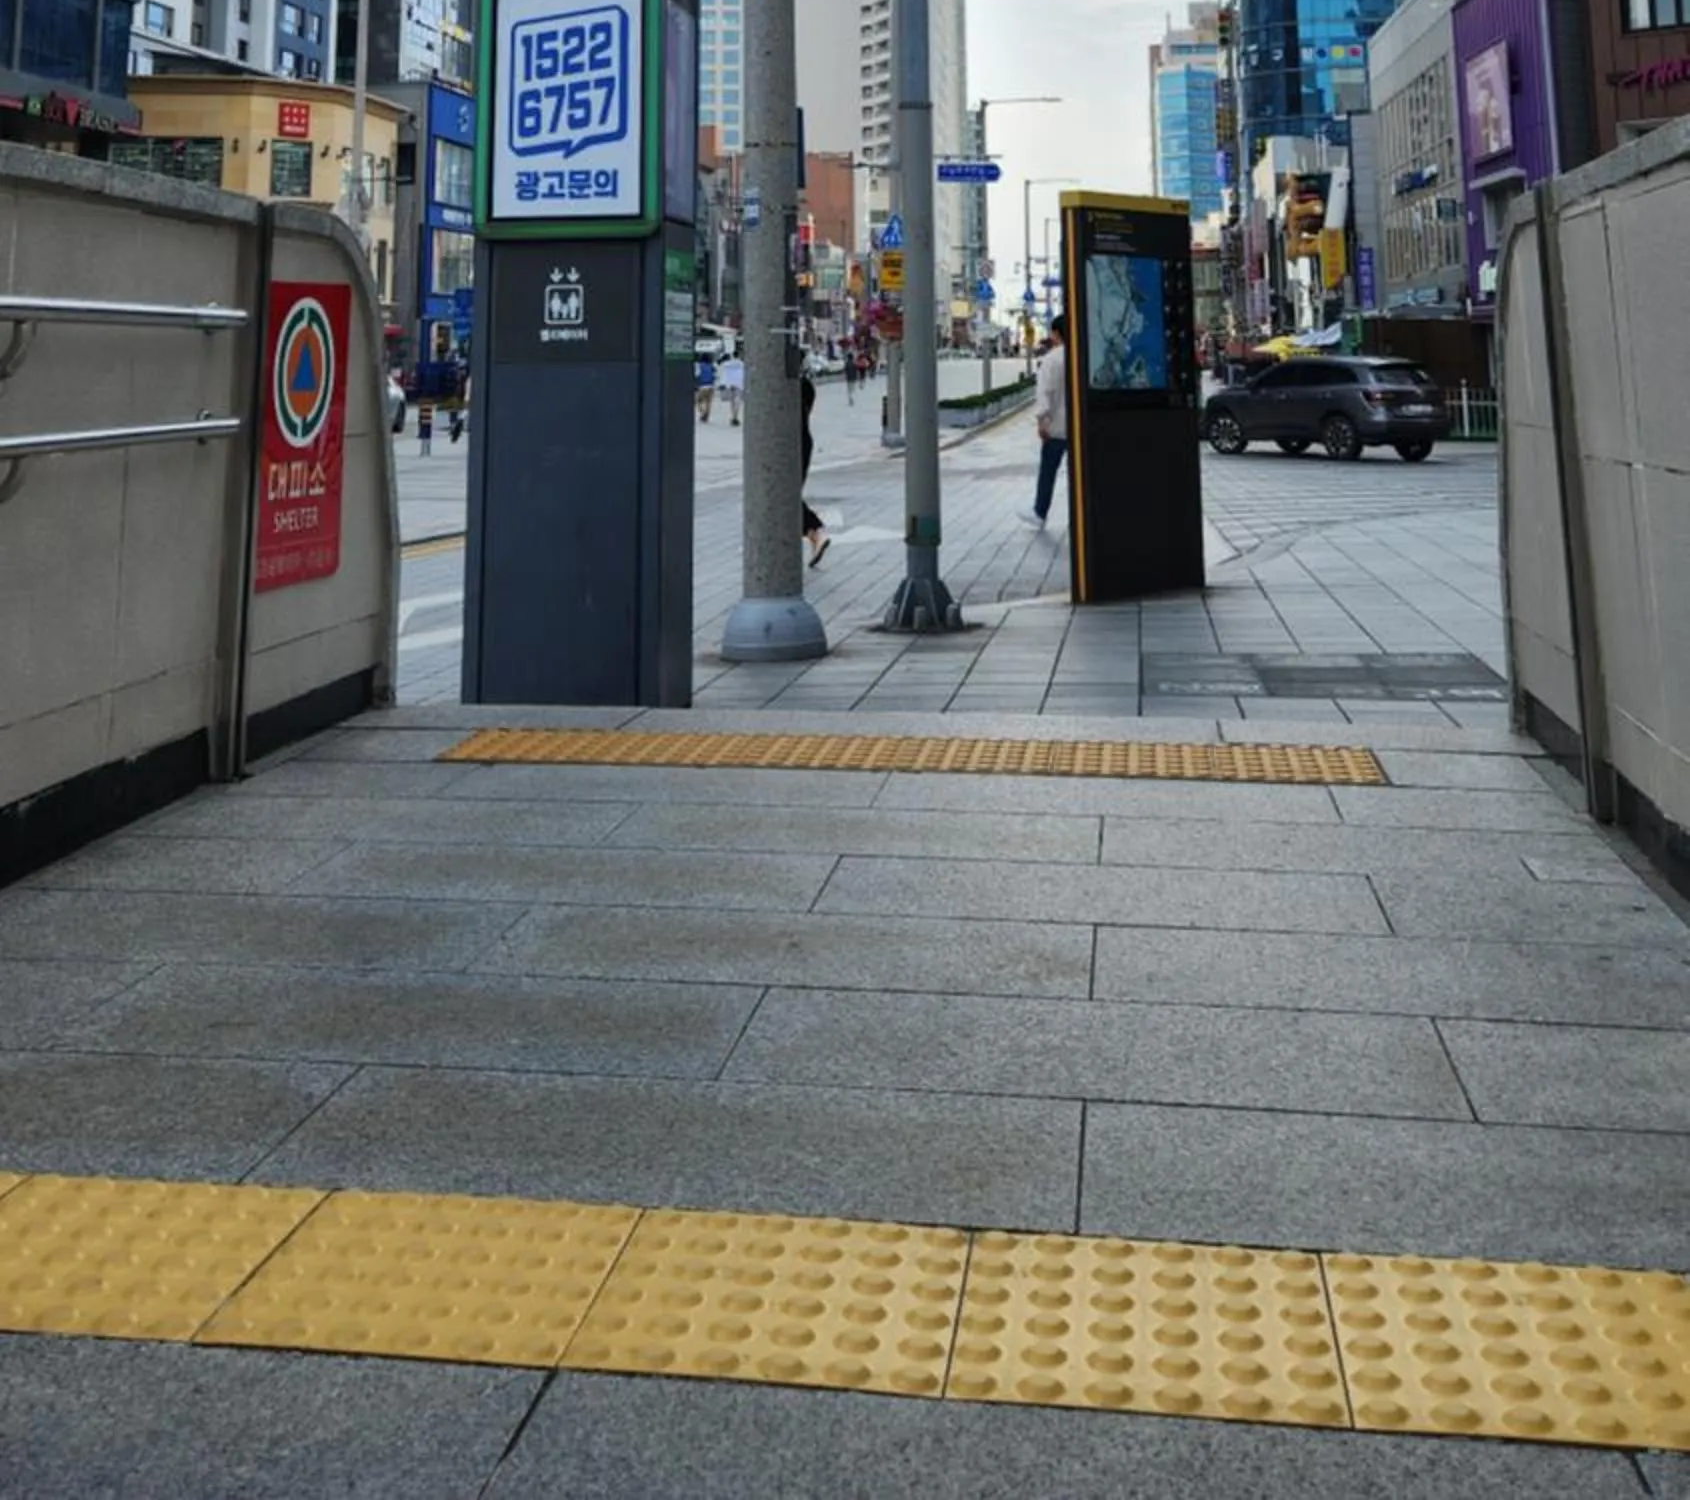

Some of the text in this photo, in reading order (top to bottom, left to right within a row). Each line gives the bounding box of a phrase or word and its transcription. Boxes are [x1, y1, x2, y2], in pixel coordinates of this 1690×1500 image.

[521, 21, 612, 81] 1522
[518, 76, 616, 138] 6757
[515, 169, 618, 201] 광고문의
[267, 461, 326, 501] 대피소
[272, 506, 319, 533] SHELTER
